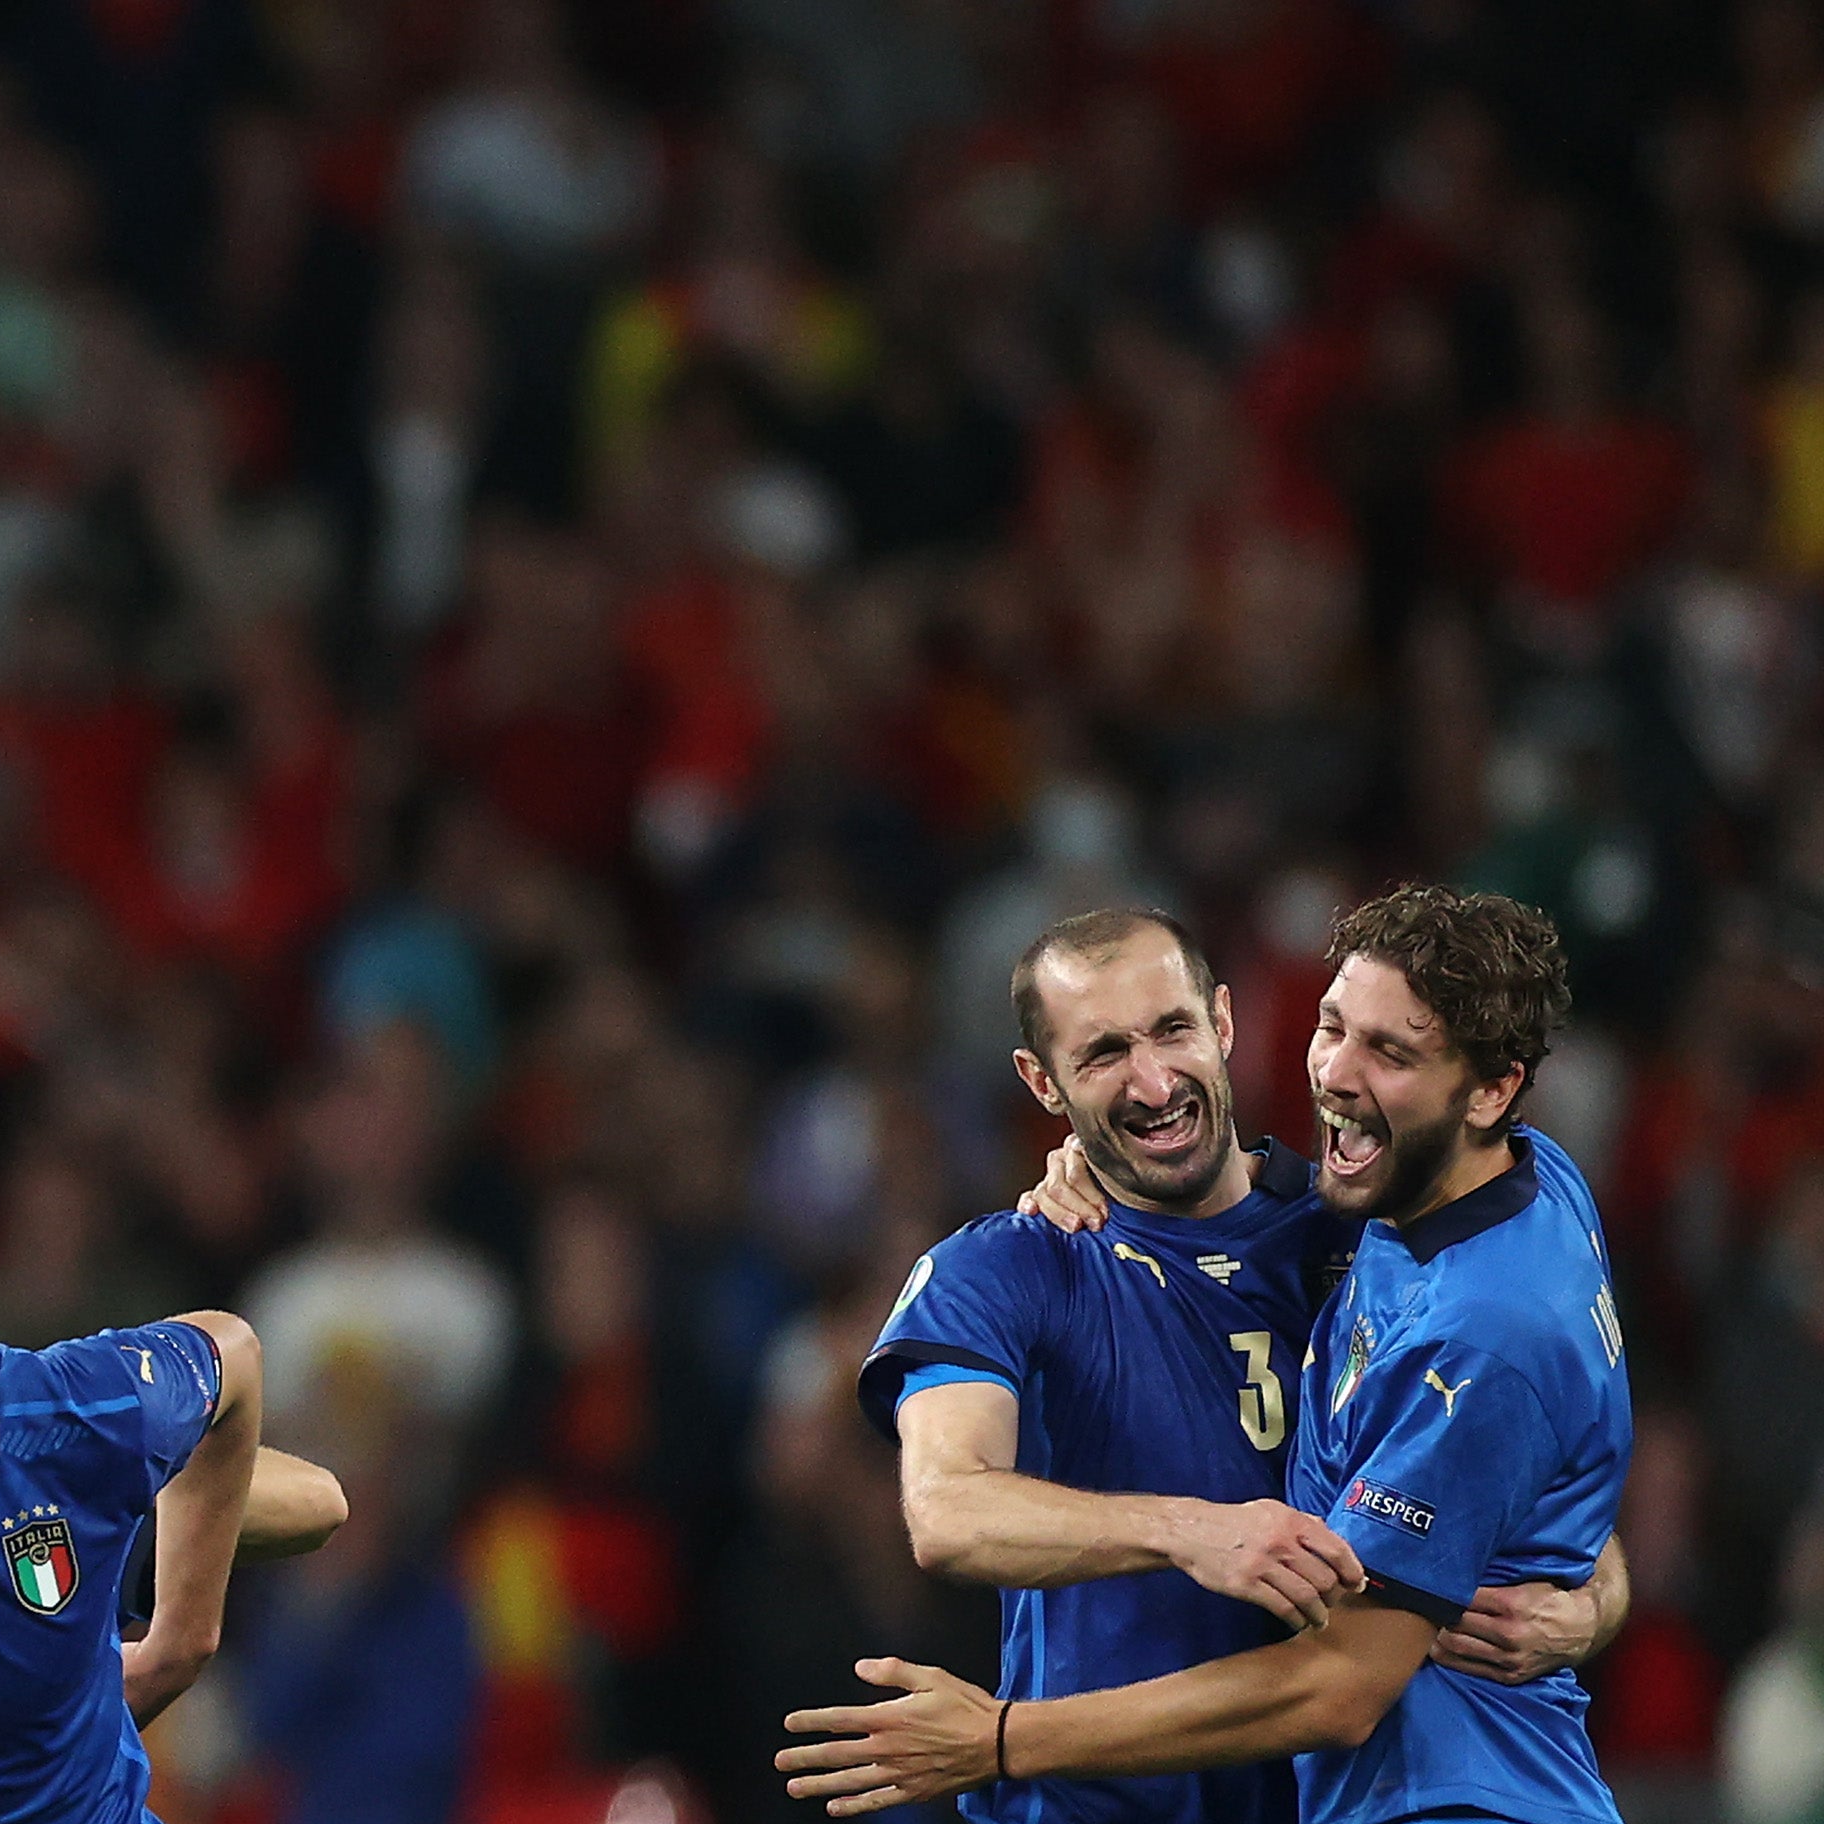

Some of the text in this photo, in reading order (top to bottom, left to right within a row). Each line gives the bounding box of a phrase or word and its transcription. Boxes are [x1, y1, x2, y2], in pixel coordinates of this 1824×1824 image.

[1229, 1331, 1285, 1451] 3
[1359, 1489, 1434, 1530] RESPECT
[10, 1526, 63, 1552] ITALIA
